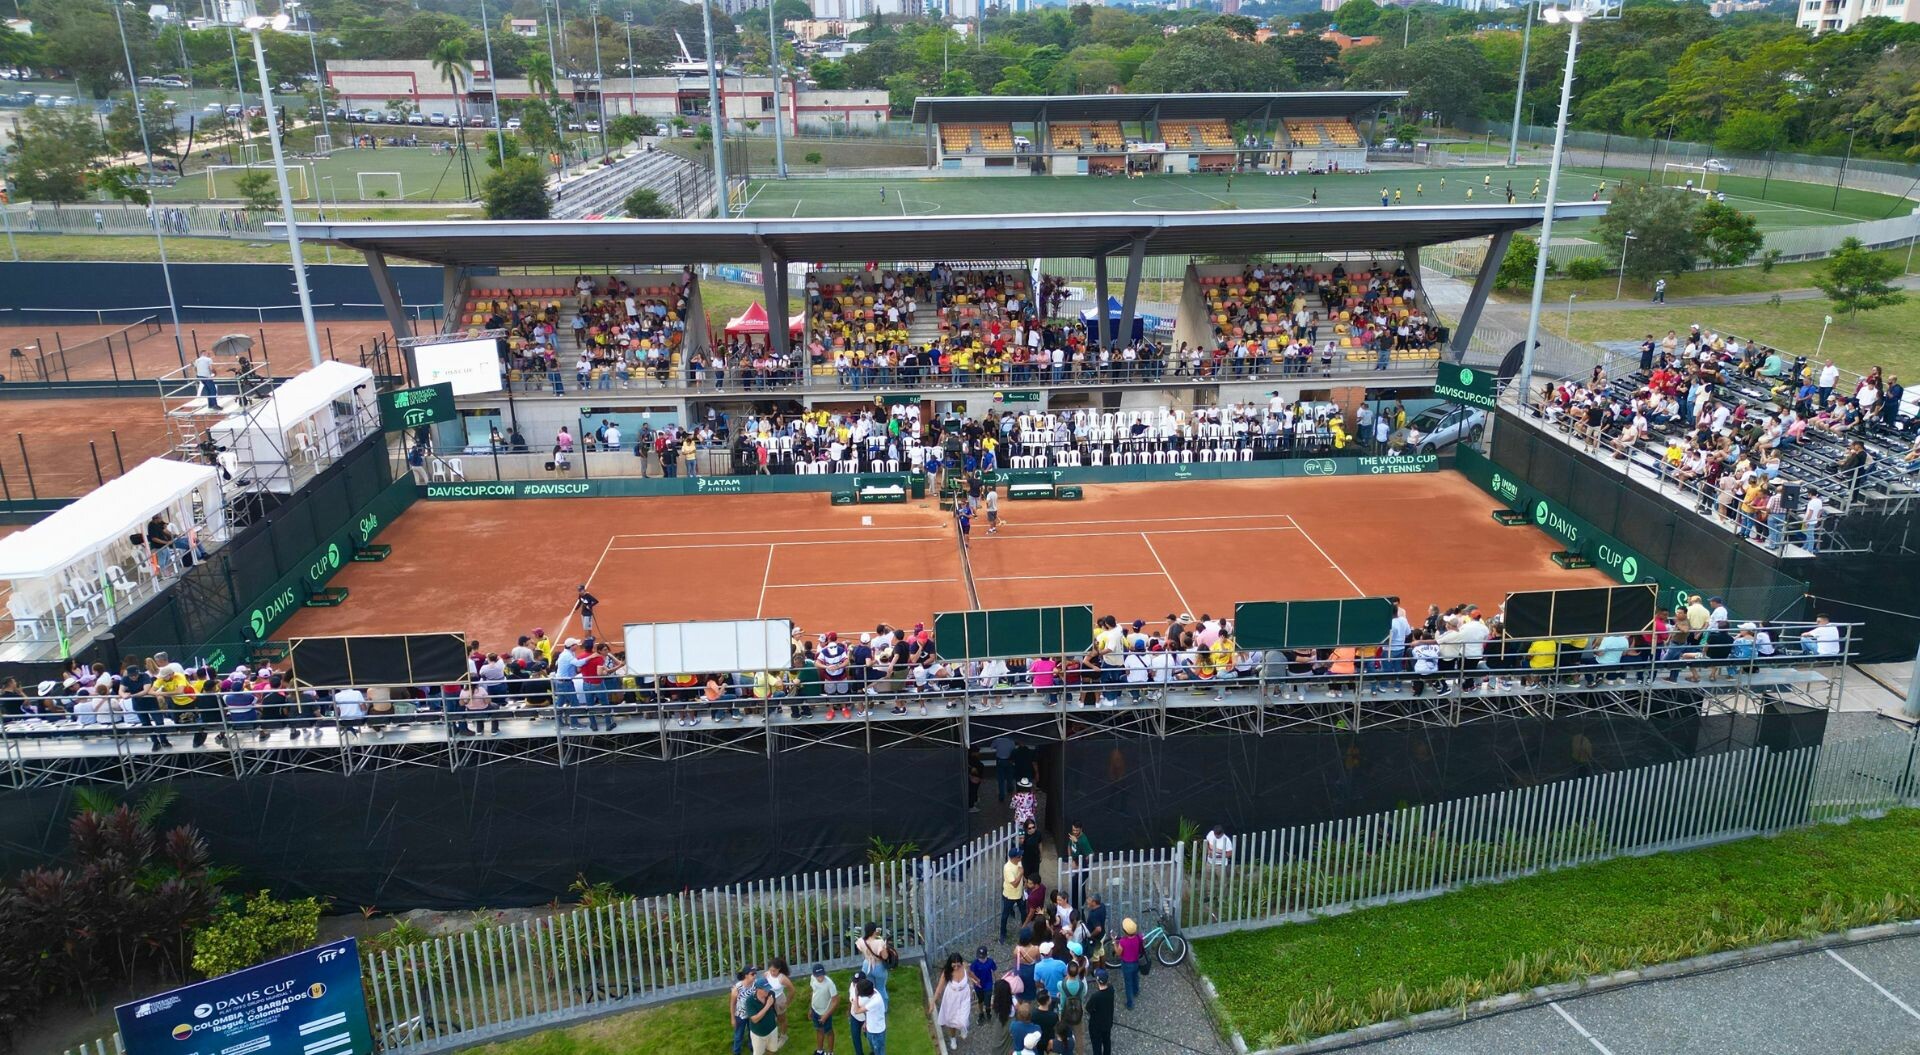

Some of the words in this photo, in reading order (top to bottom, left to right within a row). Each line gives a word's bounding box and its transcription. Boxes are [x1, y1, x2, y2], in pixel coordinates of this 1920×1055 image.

[1434, 384, 1495, 407] DAVISCUP.COM
[406, 412, 425, 425] ITF
[1358, 457, 1378, 465] THE
[1380, 456, 1415, 464] WORLD
[1417, 455, 1437, 463] CUP
[1371, 466, 1385, 474] OF
[427, 484, 515, 497] DAVISCUP.COM
[524, 483, 589, 495] #DAVISCUP
[1549, 512, 1578, 541] DAVIS
[1599, 545, 1622, 567] CUP
[265, 587, 295, 622] DAVIS
[310, 556, 328, 580] CUP
[319, 951, 338, 964] ITF
[216, 990, 260, 1011] DAVIS
[263, 979, 295, 996] CUP
[193, 1012, 244, 1032] COLOMBIA
[256, 991, 308, 1013] BARBADOS
[247, 1004, 290, 1021] Colombia
